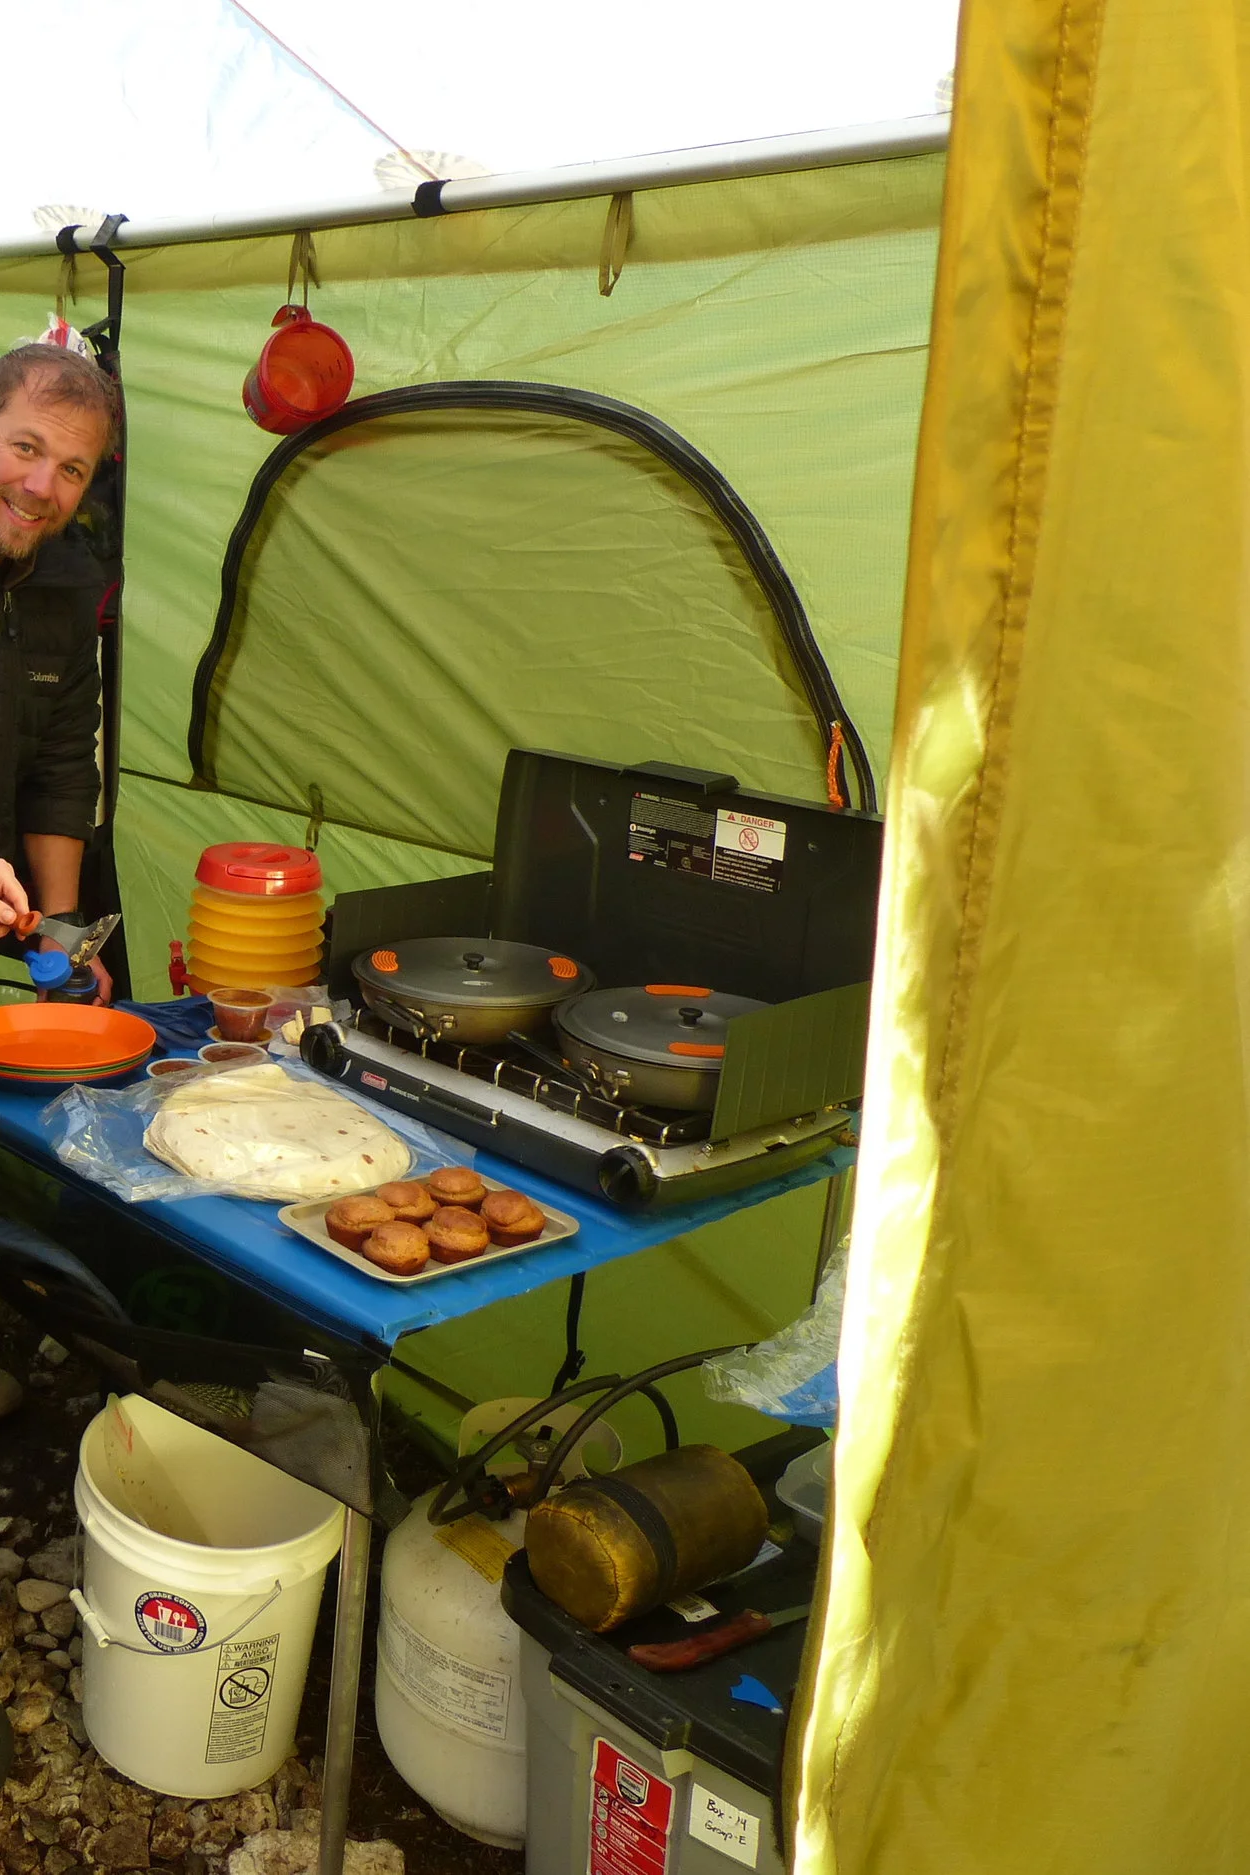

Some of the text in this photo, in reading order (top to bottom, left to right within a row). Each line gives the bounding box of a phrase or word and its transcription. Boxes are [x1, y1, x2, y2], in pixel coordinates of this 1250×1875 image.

[27, 670, 59, 683] Columbia
[740, 815, 775, 829] DANGER
[173, 1596, 205, 1627] CONTAINER
[144, 1631, 157, 1645] FOR
[158, 1641, 172, 1652] USE
[191, 1632, 204, 1647] FOOD
[234, 1636, 277, 1652] WARNING
[240, 1647, 269, 1659] AVISO
[706, 1798, 725, 1818] Box
